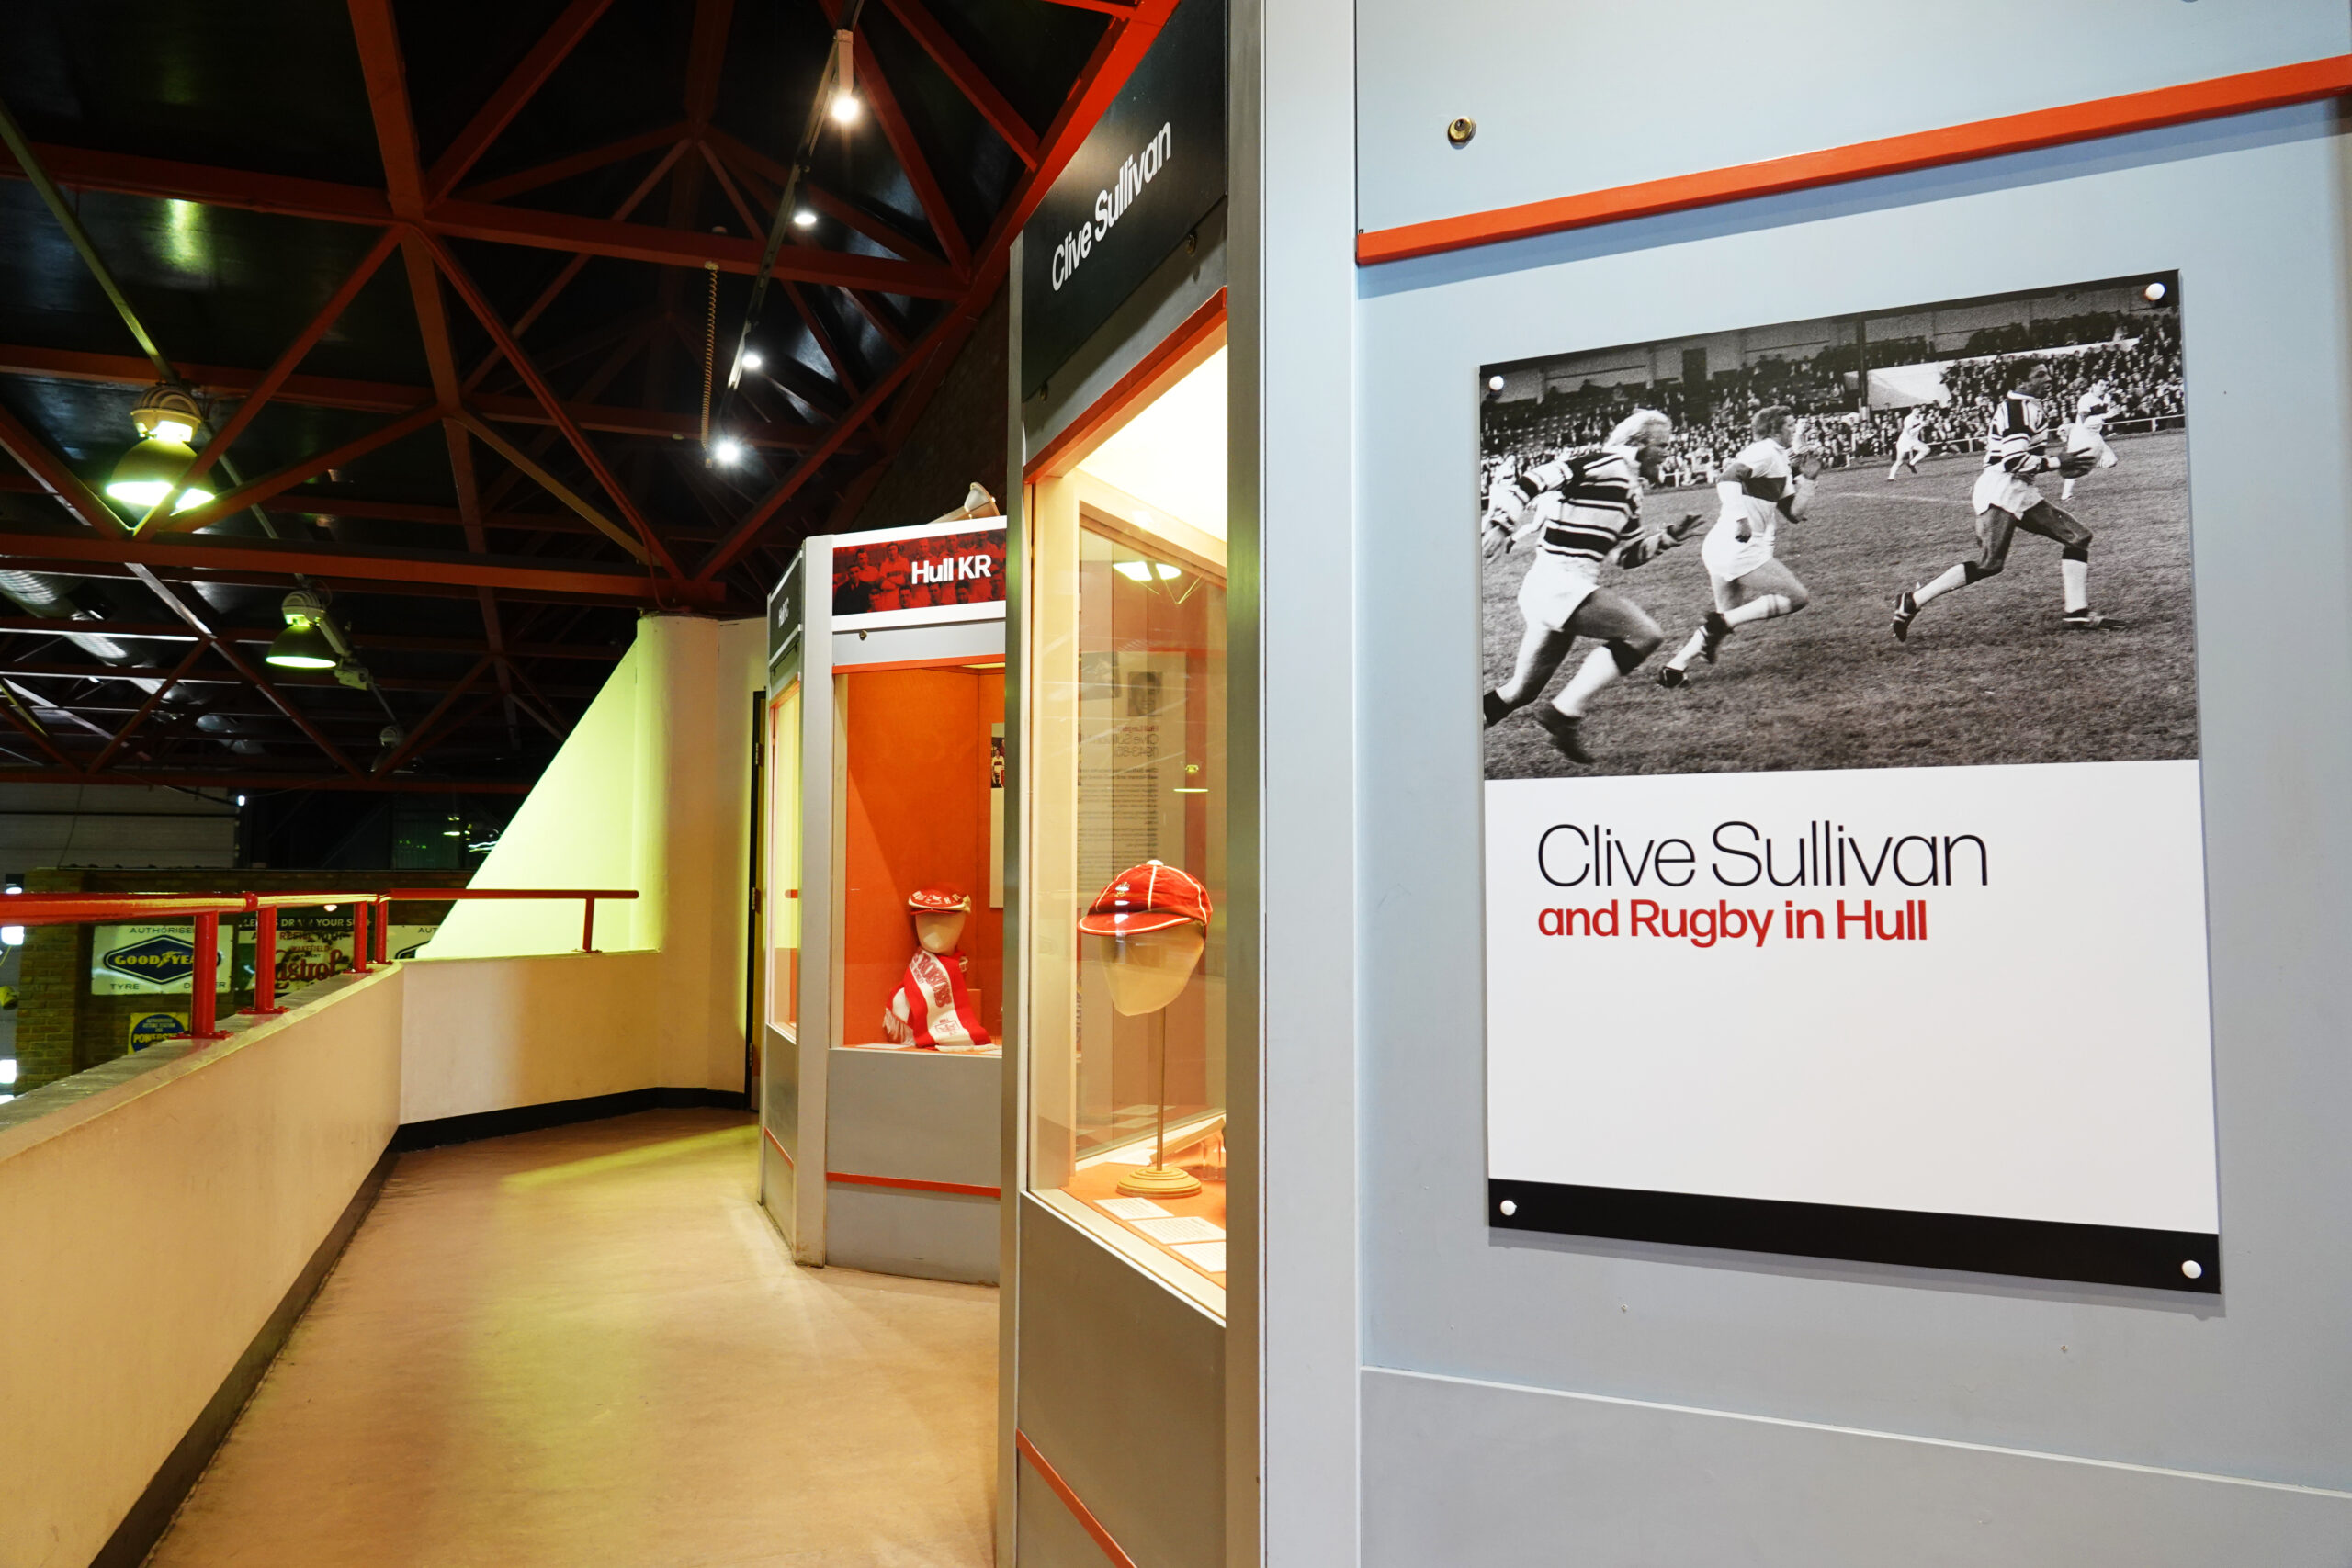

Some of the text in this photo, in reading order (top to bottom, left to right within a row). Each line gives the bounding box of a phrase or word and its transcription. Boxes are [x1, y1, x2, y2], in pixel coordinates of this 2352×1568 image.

[1052, 121, 1171, 291] Clive Sullivan
[911, 554, 992, 585] Hull KR
[1537, 819, 1989, 887] Clive Sullivan
[316, 919, 344, 927] YOUR
[1537, 898, 1928, 948] and Rugby in Hull
[114, 953, 195, 966] GOODYEA
